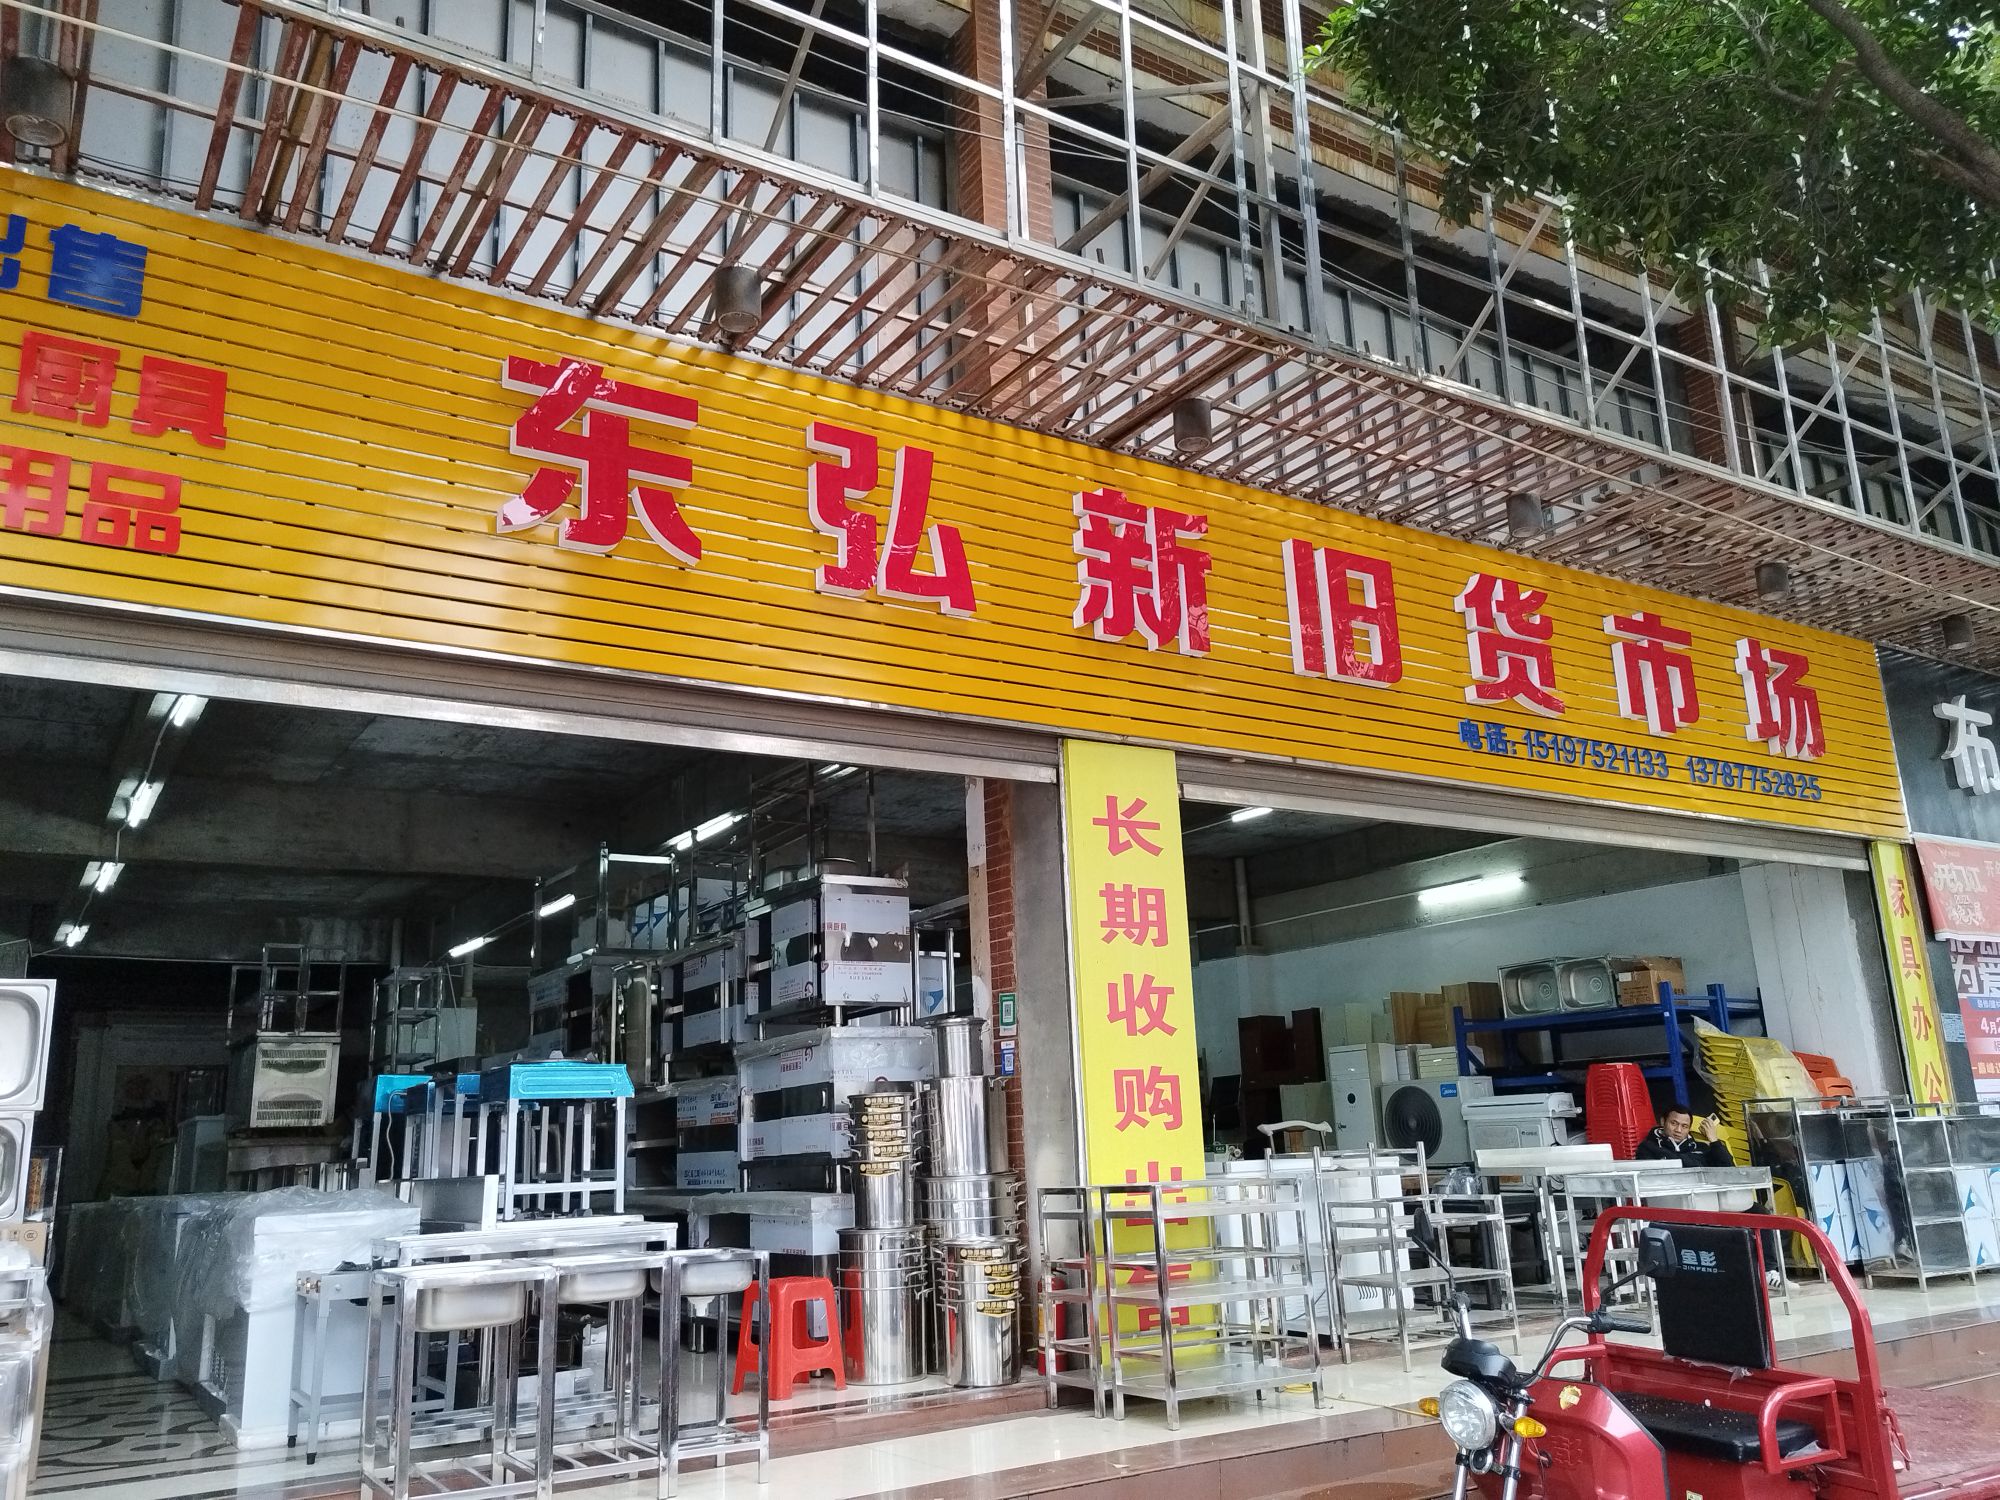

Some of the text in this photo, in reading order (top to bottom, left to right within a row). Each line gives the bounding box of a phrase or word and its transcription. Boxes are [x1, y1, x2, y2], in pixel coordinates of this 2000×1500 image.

[11, 330, 228, 450] 厨具
[497, 354, 1827, 763] 东弘新旧货市场
[1684, 755, 1823, 801] 13787752825
